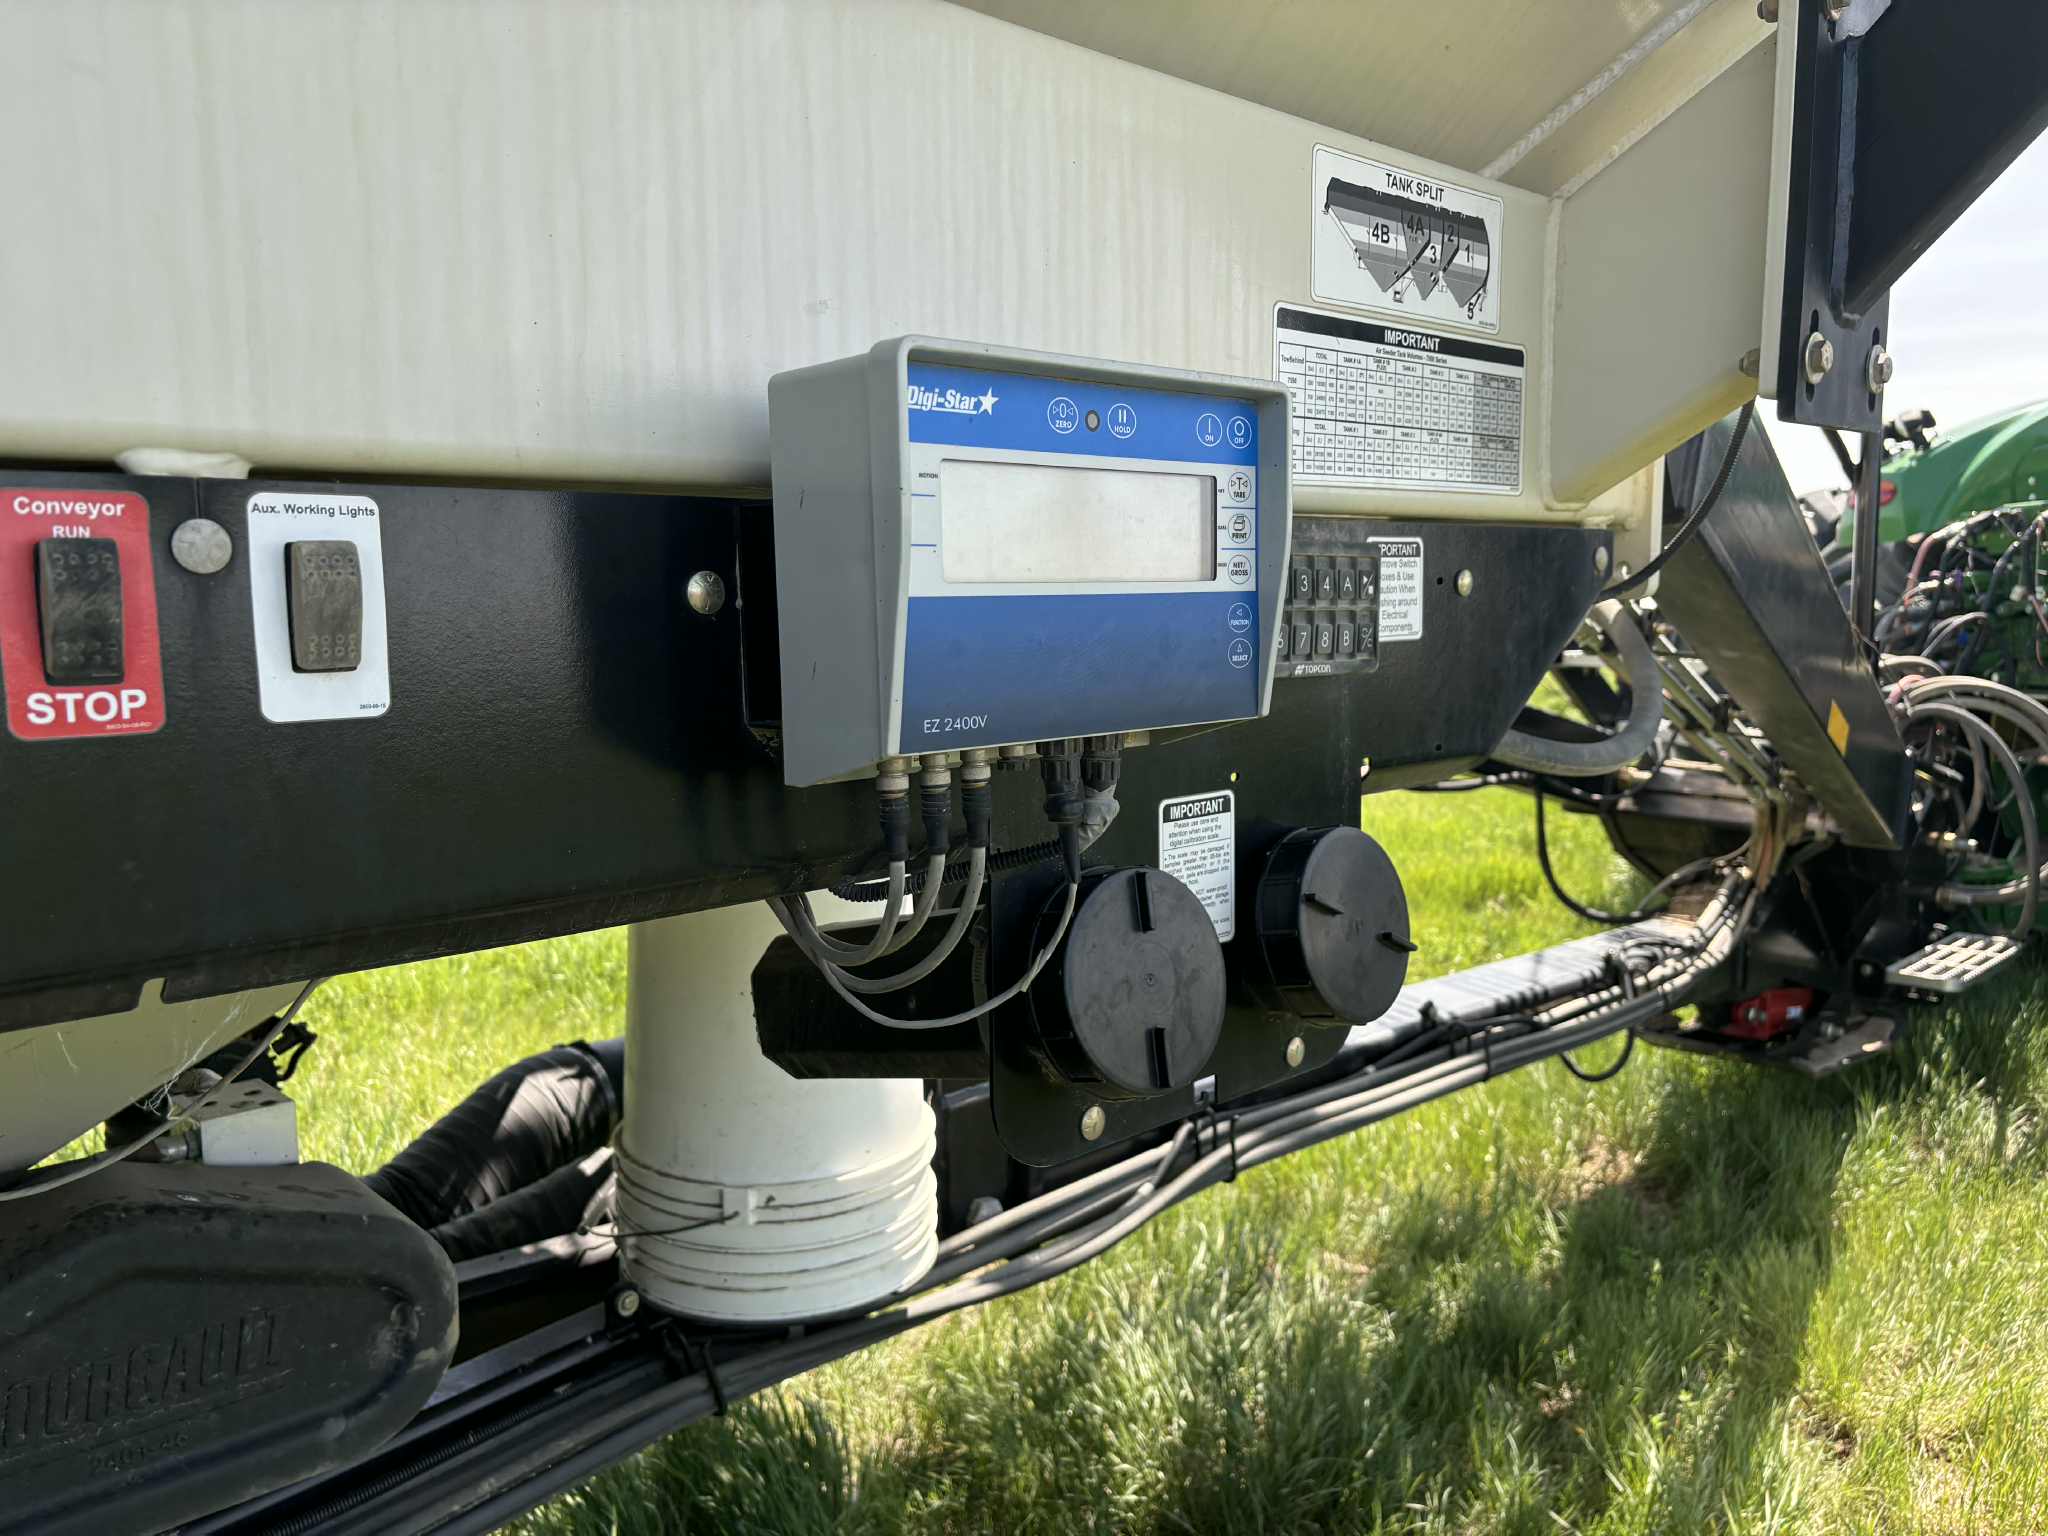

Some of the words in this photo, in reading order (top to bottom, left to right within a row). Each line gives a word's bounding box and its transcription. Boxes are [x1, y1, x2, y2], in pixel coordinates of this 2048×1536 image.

[1385, 172, 1414, 195] TANK
[1416, 181, 1445, 202] SPLIT
[1371, 221, 1390, 244] 4B
[1406, 215, 1425, 236] 4A
[1447, 225, 1454, 242] 2
[1430, 245, 1437, 264] 3
[1464, 244, 1470, 263] 1
[1467, 302, 1474, 320] 5
[1384, 329, 1441, 352] IMPORTANT
[907, 385, 979, 412] Digi-Star
[1055, 420, 1073, 429] ZERO
[1114, 425, 1131, 434] HOLD
[1204, 434, 1214, 443] ON
[12, 496, 126, 520] Conveyor
[251, 502, 281, 514] Aux.
[283, 503, 336, 518] Working
[338, 505, 376, 519] Lights
[52, 525, 91, 539] RUN
[1378, 543, 1418, 556] PORTANT
[1381, 560, 1398, 569] move
[1398, 559, 1418, 569] Switch
[1300, 575, 1308, 592] 3
[1323, 576, 1330, 592] 4
[1343, 576, 1353, 592] A
[1381, 573, 1396, 582] oxes
[1402, 572, 1415, 581] Use
[1398, 584, 1416, 594] When
[1381, 609, 1409, 620] Electrical
[1300, 631, 1307, 649] 7
[1321, 631, 1329, 648] 8
[1343, 630, 1350, 646] B
[1231, 654, 1249, 662] SELECT
[26, 688, 148, 725] STOP
[923, 718, 941, 733] EZ
[944, 715, 988, 731] 2400V
[1169, 798, 1225, 820] IMPORTANT
